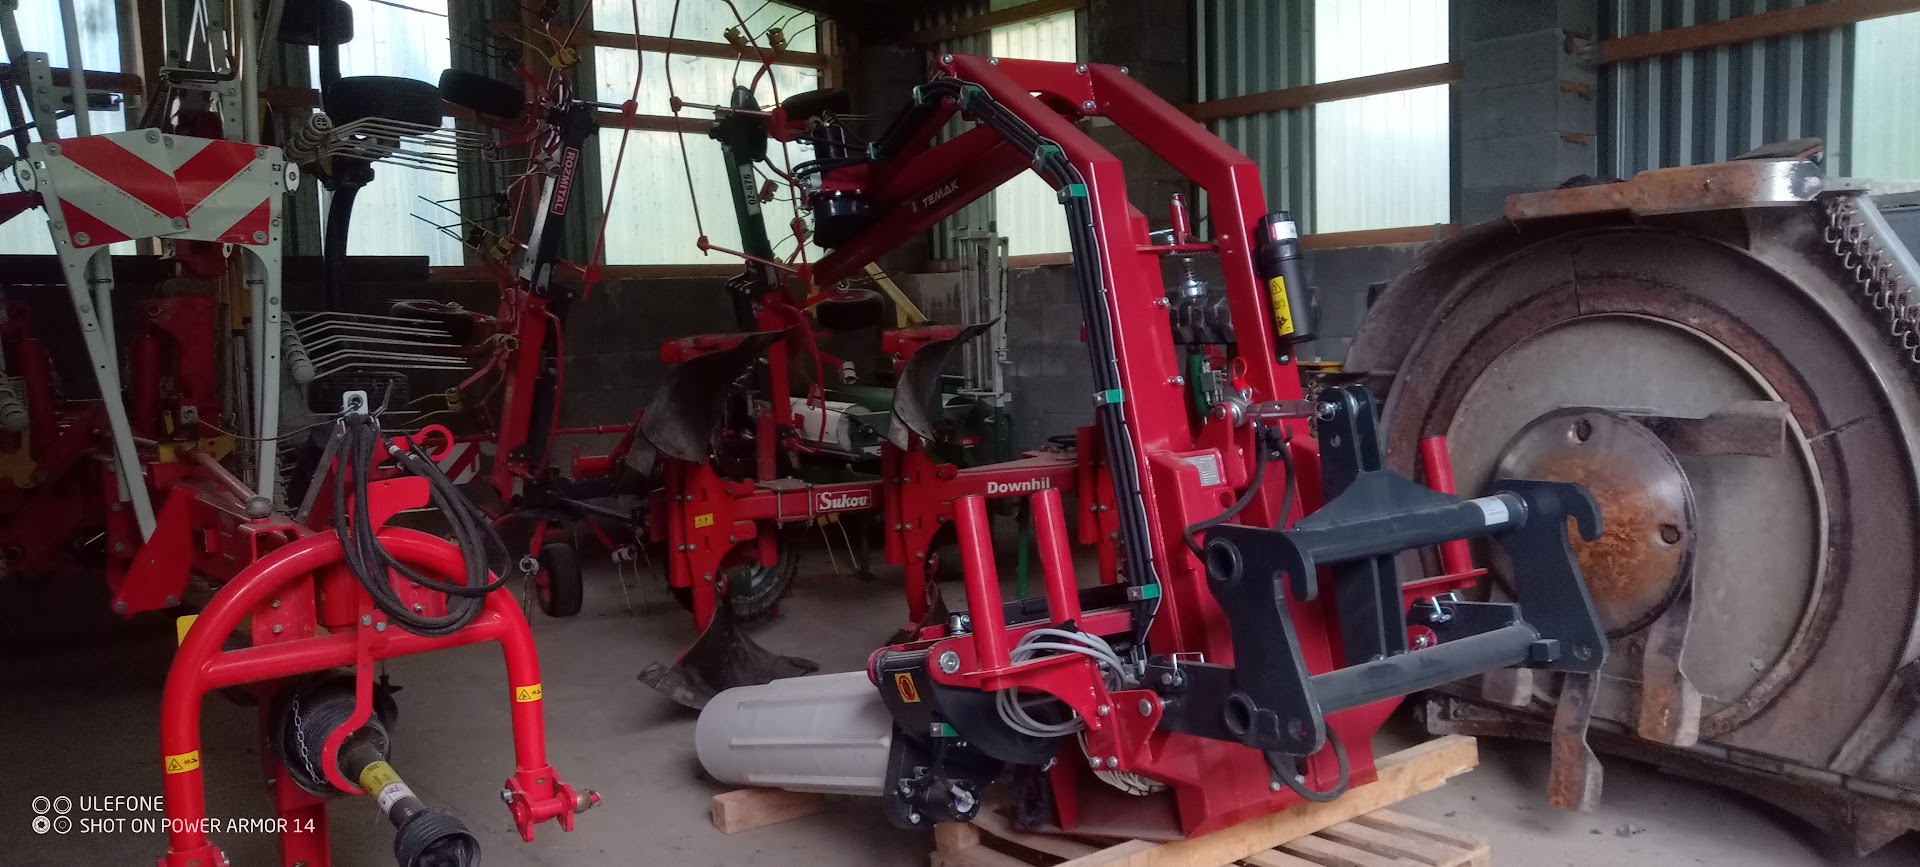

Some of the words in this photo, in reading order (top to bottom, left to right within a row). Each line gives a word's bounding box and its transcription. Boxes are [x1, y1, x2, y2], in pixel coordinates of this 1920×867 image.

[554, 151, 576, 210] ROZMITAL
[922, 179, 959, 208] TEMAK
[987, 476, 1050, 495] Downhil
[819, 491, 869, 510] Sukov
